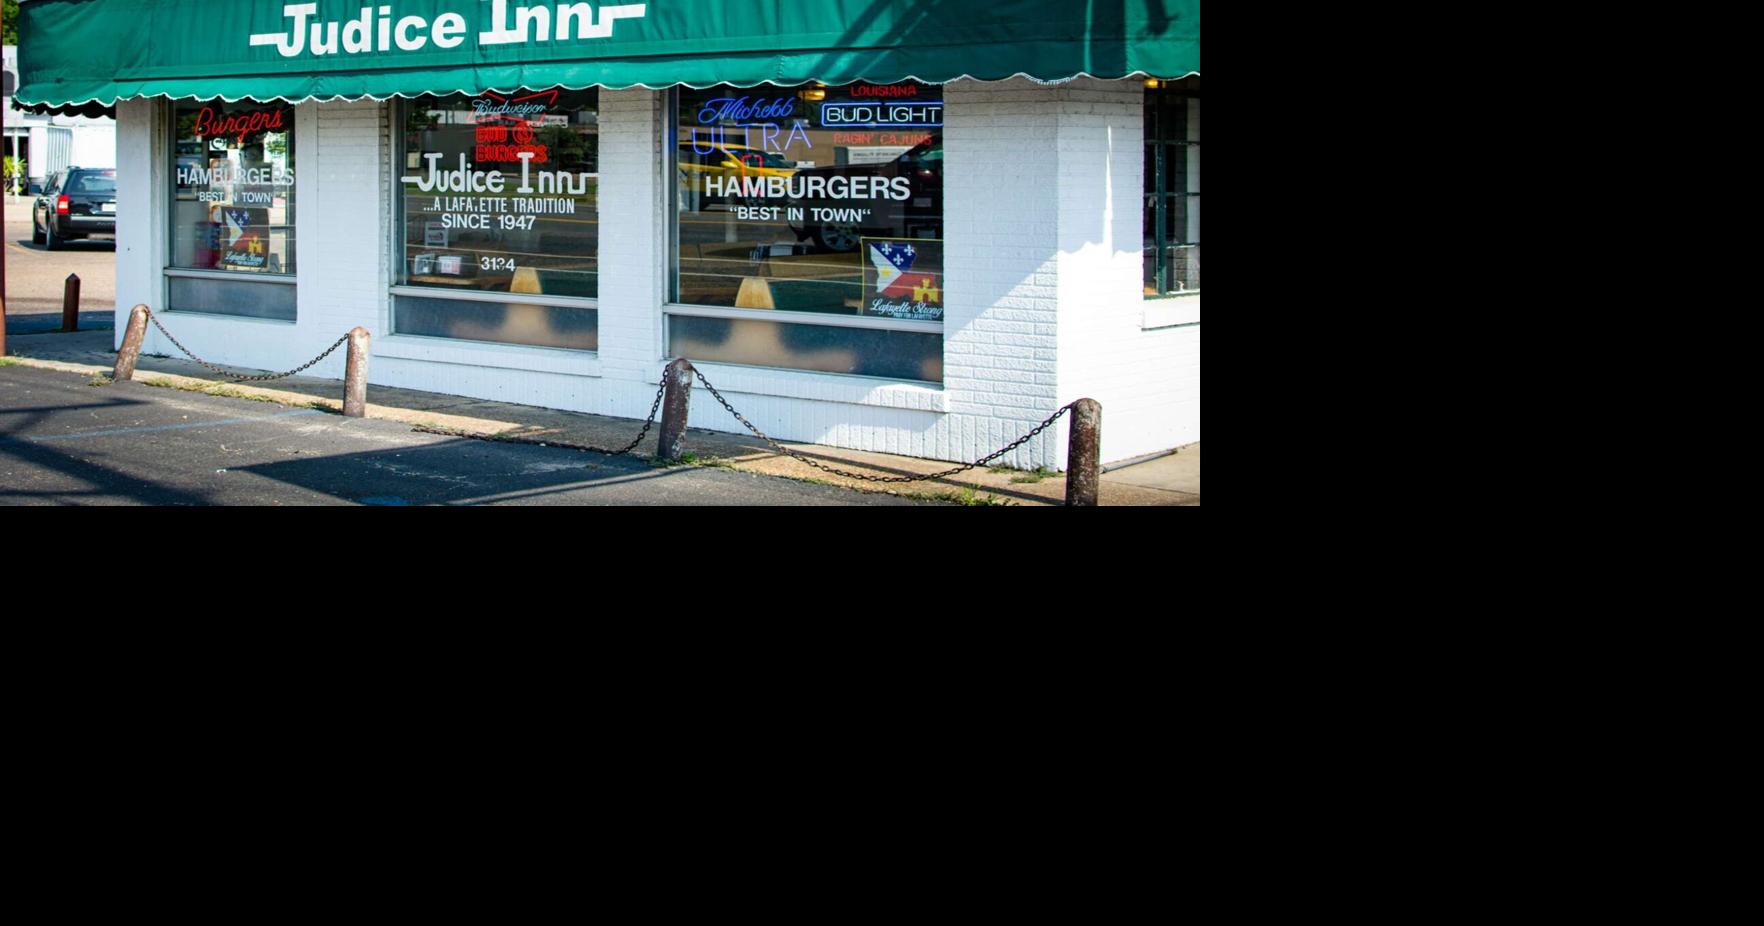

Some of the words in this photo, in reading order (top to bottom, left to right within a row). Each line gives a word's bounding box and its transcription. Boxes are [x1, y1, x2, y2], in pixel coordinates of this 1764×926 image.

[249, 3, 466, 57] Judice
[478, 0, 647, 45] Inn
[850, 84, 917, 97] LOUISIANA
[472, 98, 547, 115] Budweiser
[826, 106, 873, 122] BUD
[876, 106, 942, 123] LIGHT
[194, 107, 284, 144] Burgers
[691, 121, 813, 155] ULTRA
[879, 133, 933, 146] CAJUNS
[401, 152, 505, 193] Judice
[516, 151, 600, 195] Inn
[705, 175, 911, 200] HAMBURGERS
[512, 197, 575, 214] TRADITION
[787, 206, 804, 221] IN
[441, 212, 491, 230] SINCE
[497, 214, 537, 231] 1947
[870, 298, 911, 315] Lafayette
[912, 301, 944, 318] Strong
